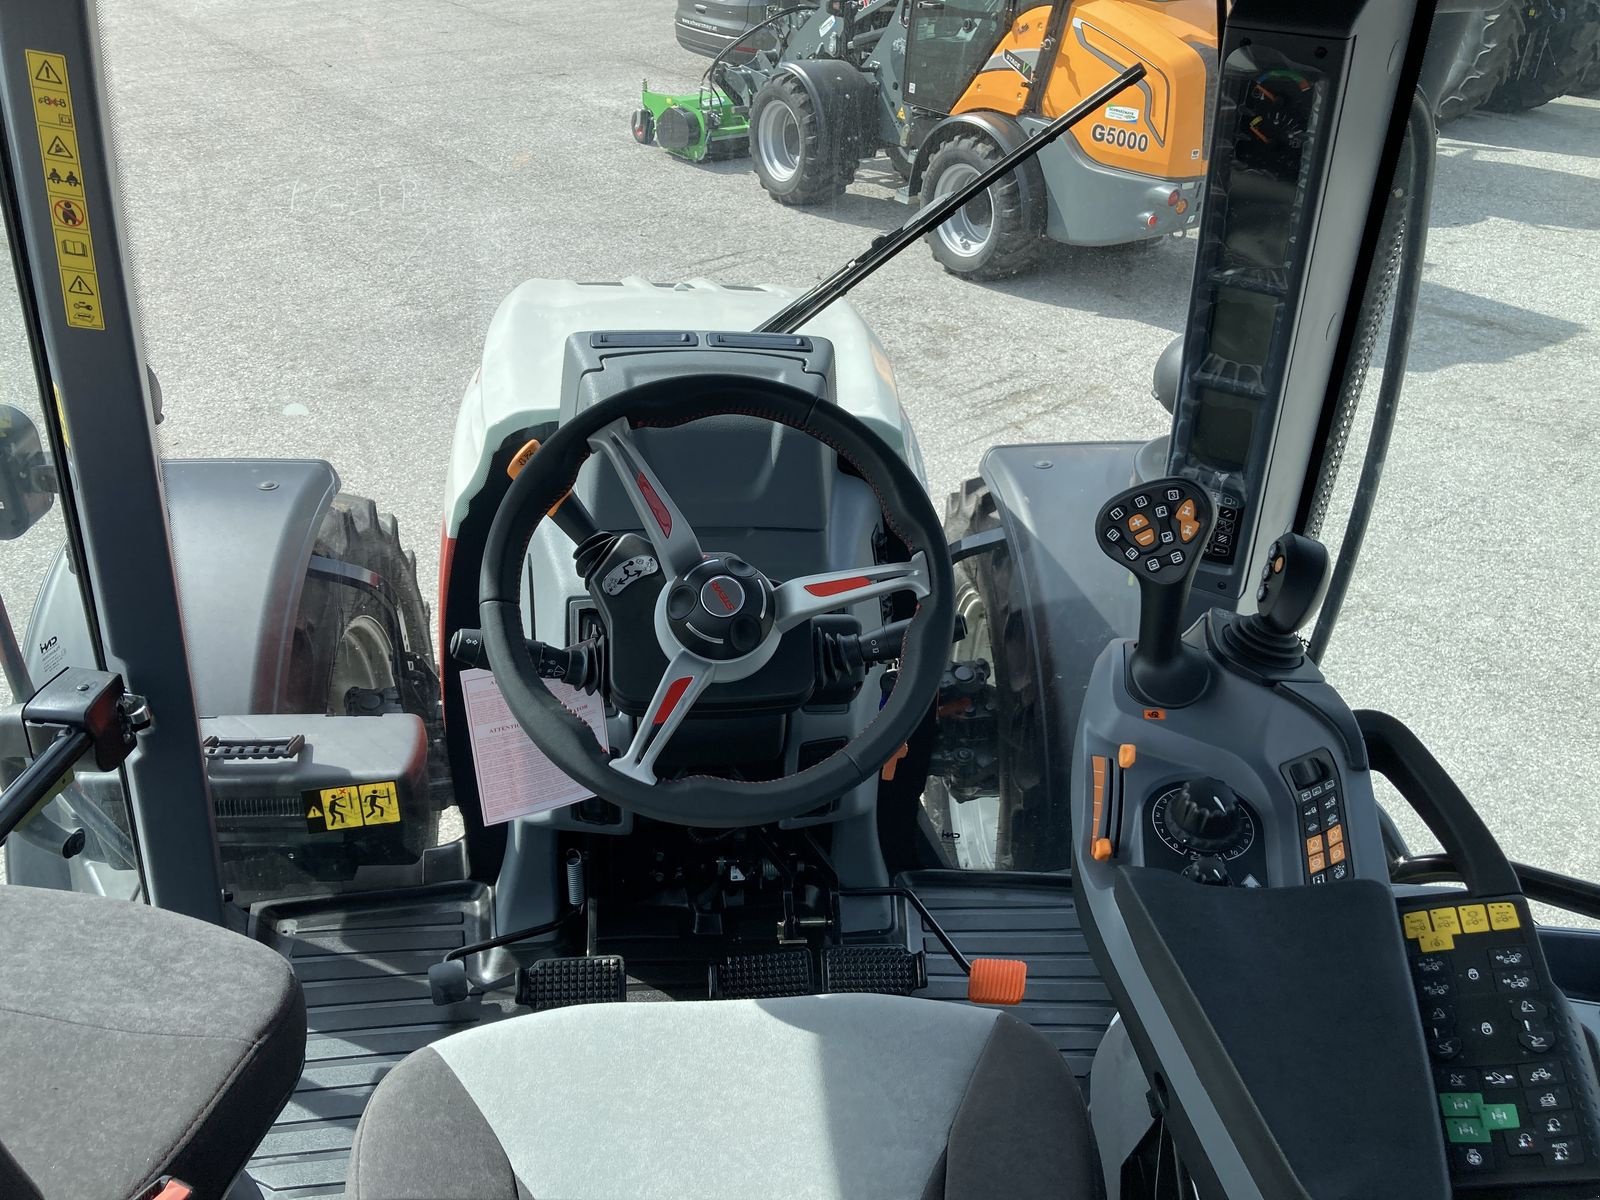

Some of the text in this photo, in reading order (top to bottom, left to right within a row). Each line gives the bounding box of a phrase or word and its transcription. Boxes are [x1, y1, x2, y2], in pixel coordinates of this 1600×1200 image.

[1005, 54, 1021, 70] STAGE
[1091, 123, 1149, 152] G5000
[489, 723, 521, 734] ATTENTIO
